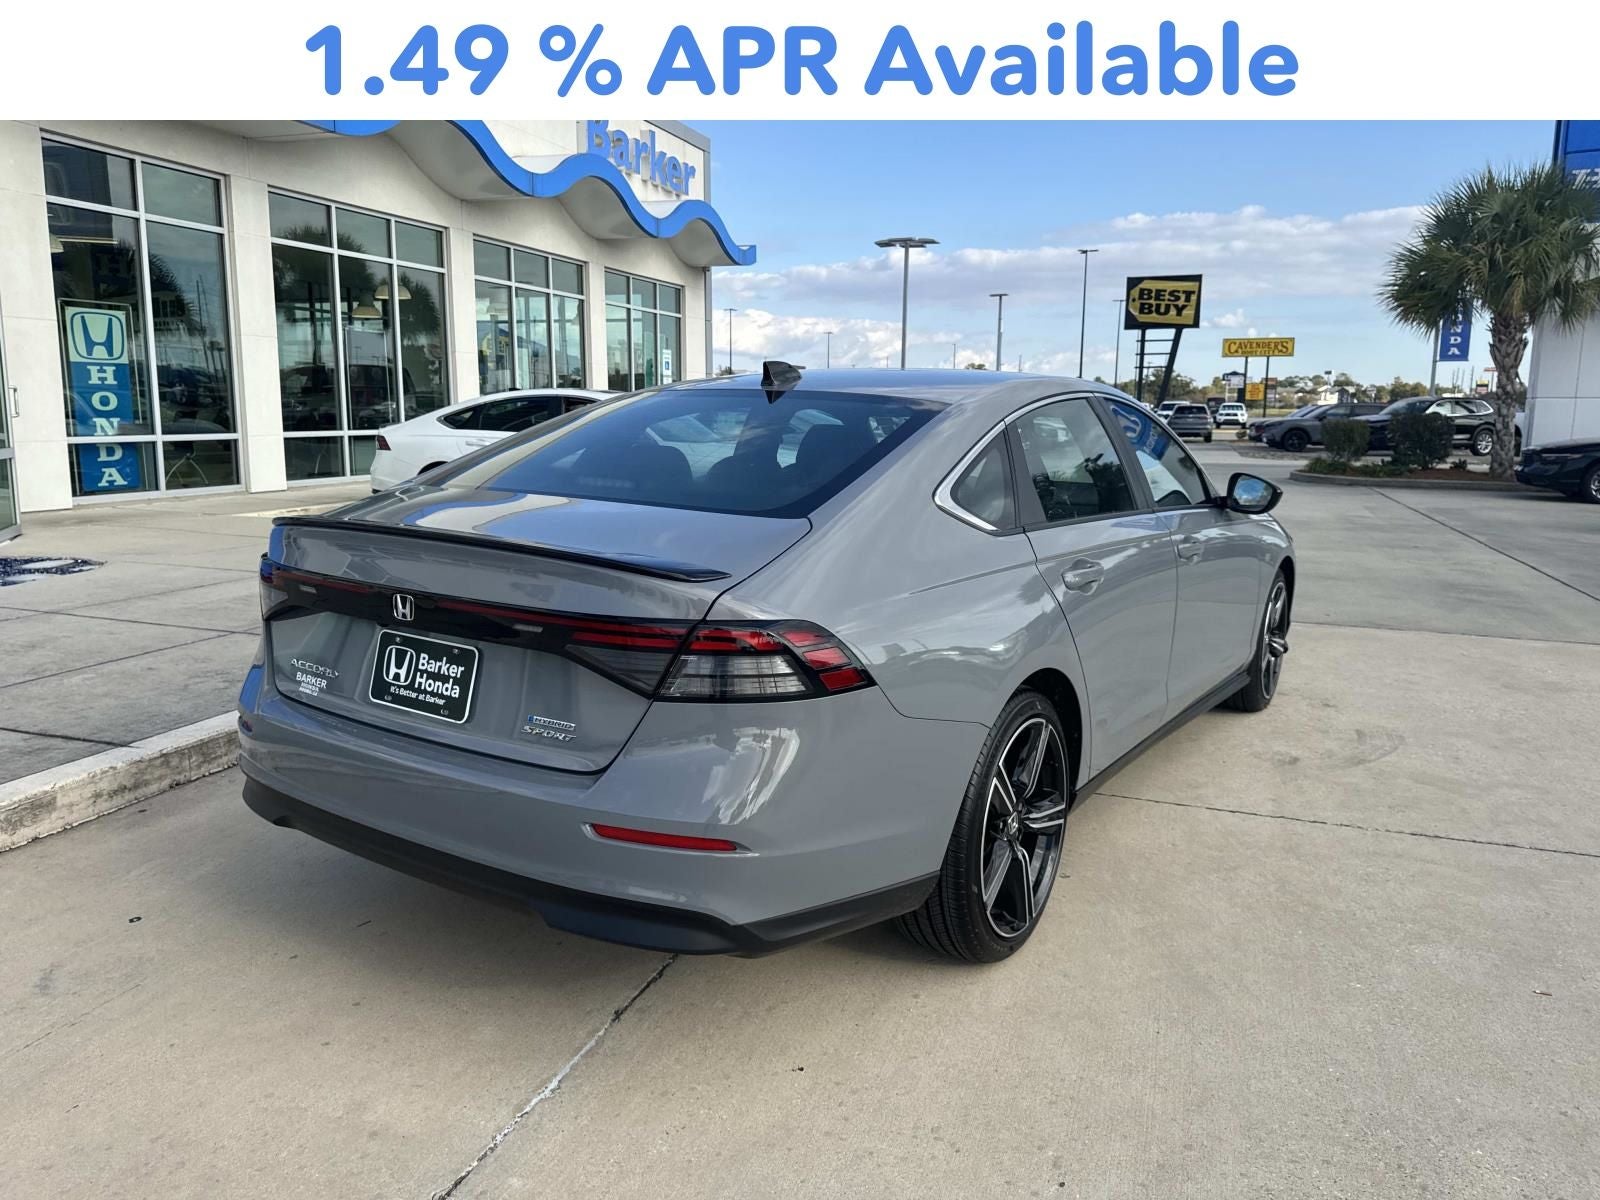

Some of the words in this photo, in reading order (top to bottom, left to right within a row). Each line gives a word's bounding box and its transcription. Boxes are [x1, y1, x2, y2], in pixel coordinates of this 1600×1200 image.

[587, 120, 696, 196] Barker
[1139, 288, 1196, 303] BEST
[1139, 303, 1190, 317] BUY
[87, 365, 128, 487] HONDA
[418, 652, 465, 679] Barker
[296, 671, 328, 689] BARKER
[414, 671, 460, 699] Honda
[399, 687, 418, 699] Better
[418, 693, 426, 701] at
[425, 694, 447, 706] Barker
[533, 716, 576, 731] HYBRID
[521, 725, 577, 741] SPORT
